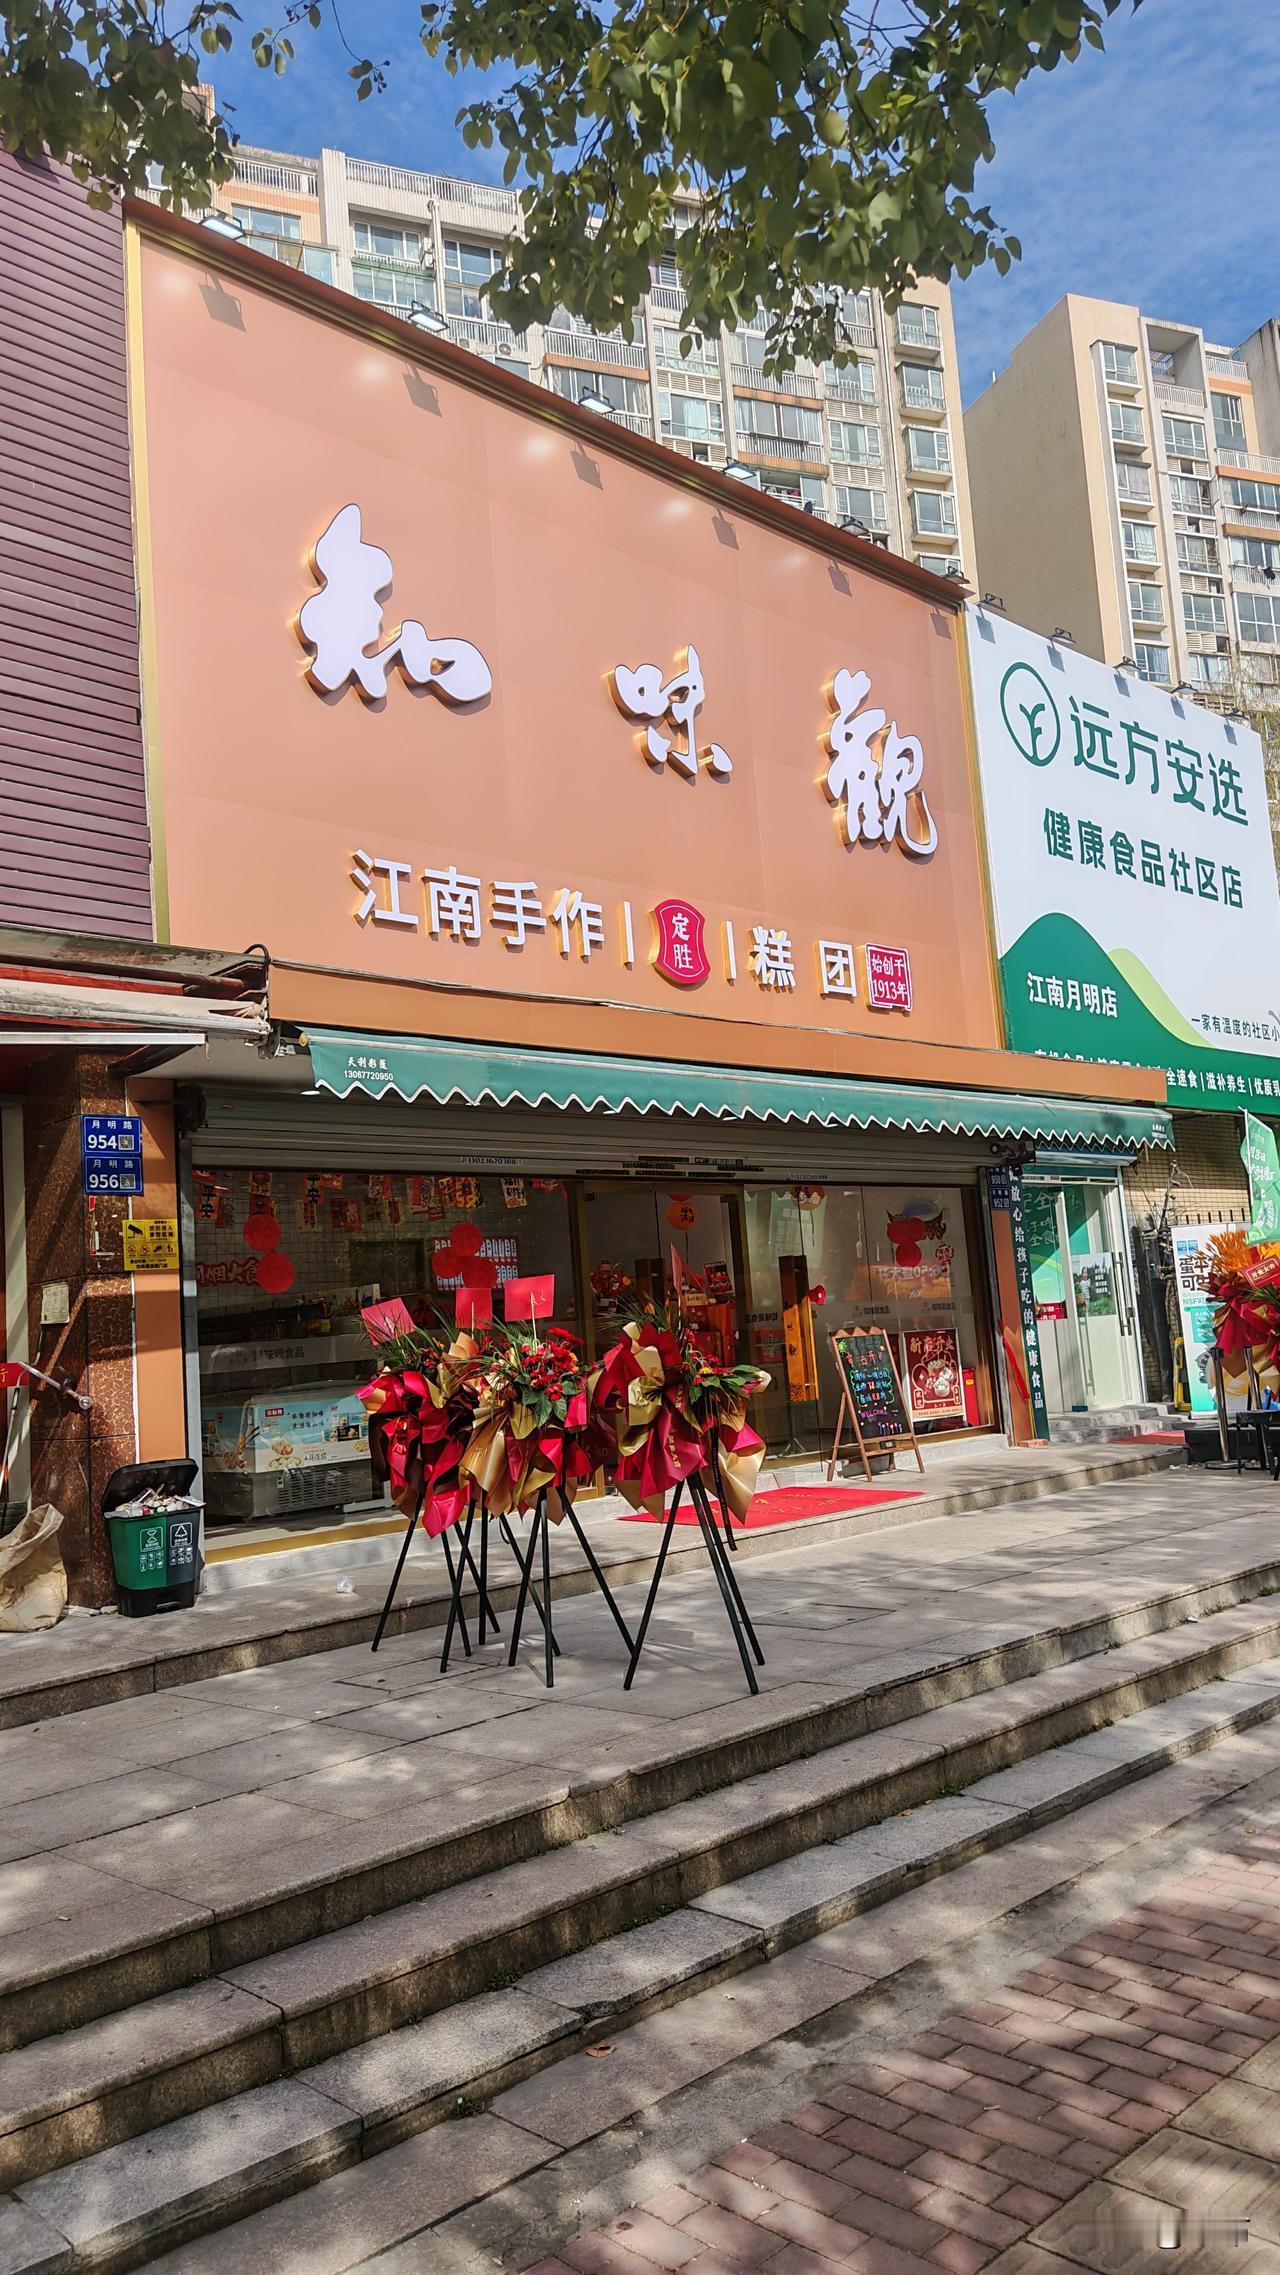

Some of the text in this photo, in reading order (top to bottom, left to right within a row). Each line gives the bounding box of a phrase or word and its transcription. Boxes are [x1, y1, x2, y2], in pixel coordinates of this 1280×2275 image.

[1069, 695, 1249, 827] 远方安选
[1043, 807, 1244, 909] 健康食品社区店
[354, 849, 605, 958] 江南手作
[671, 910, 695, 971] 定胜
[872, 978, 909, 1002] 1913年
[1027, 972, 1118, 1018] 江南月明店
[1191, 1013, 1280, 1042] 一家有温度的社区小
[344, 1070, 394, 1081] 13067720950
[1158, 1066, 1198, 1089] 全速食
[1206, 1071, 1247, 1094] 滋补养生
[92, 1120, 133, 1130] 月明路
[88, 1134, 117, 1149] 954
[93, 1159, 134, 1169] 月明路
[89, 1174, 119, 1188] 956
